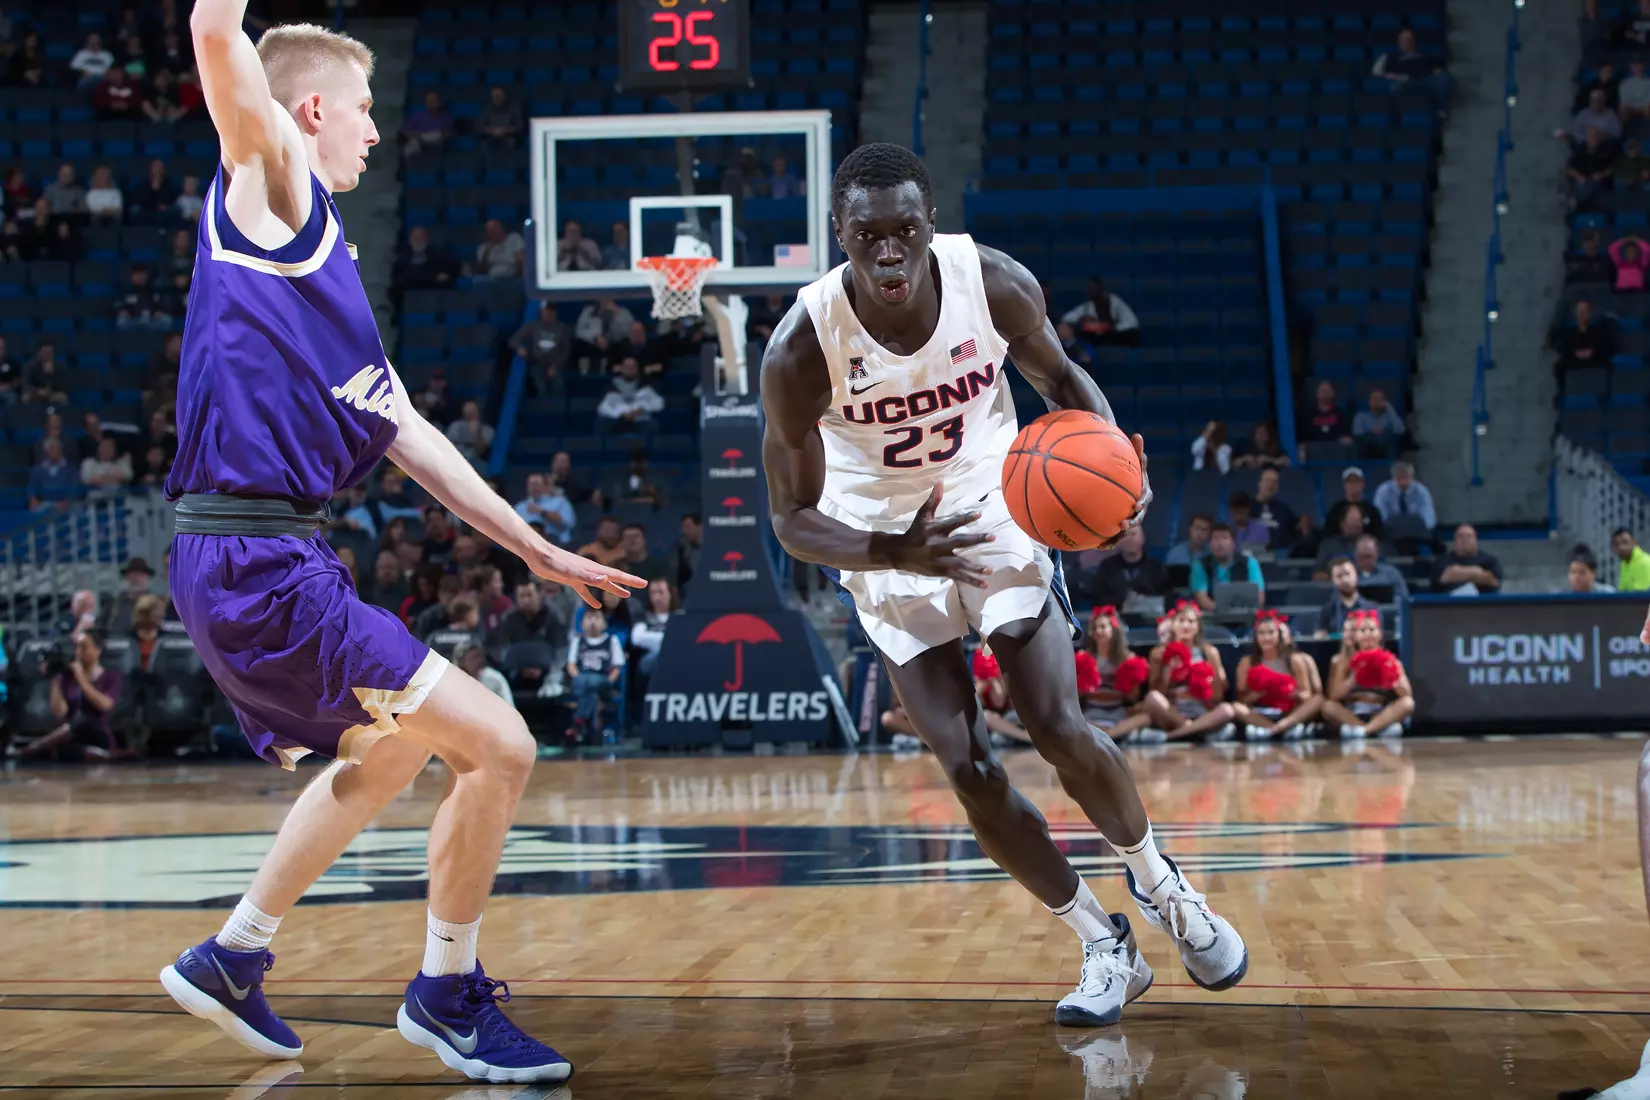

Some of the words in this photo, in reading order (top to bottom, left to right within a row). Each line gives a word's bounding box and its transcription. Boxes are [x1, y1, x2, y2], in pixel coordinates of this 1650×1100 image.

[649, 10, 719, 71] 25
[331, 364, 398, 426] Mic
[843, 363, 994, 425] UCONN
[883, 414, 964, 468] 23
[1454, 633, 1584, 663] UCONN
[1469, 666, 1571, 685] HEALTH
[645, 692, 828, 721] TRAVELERS
